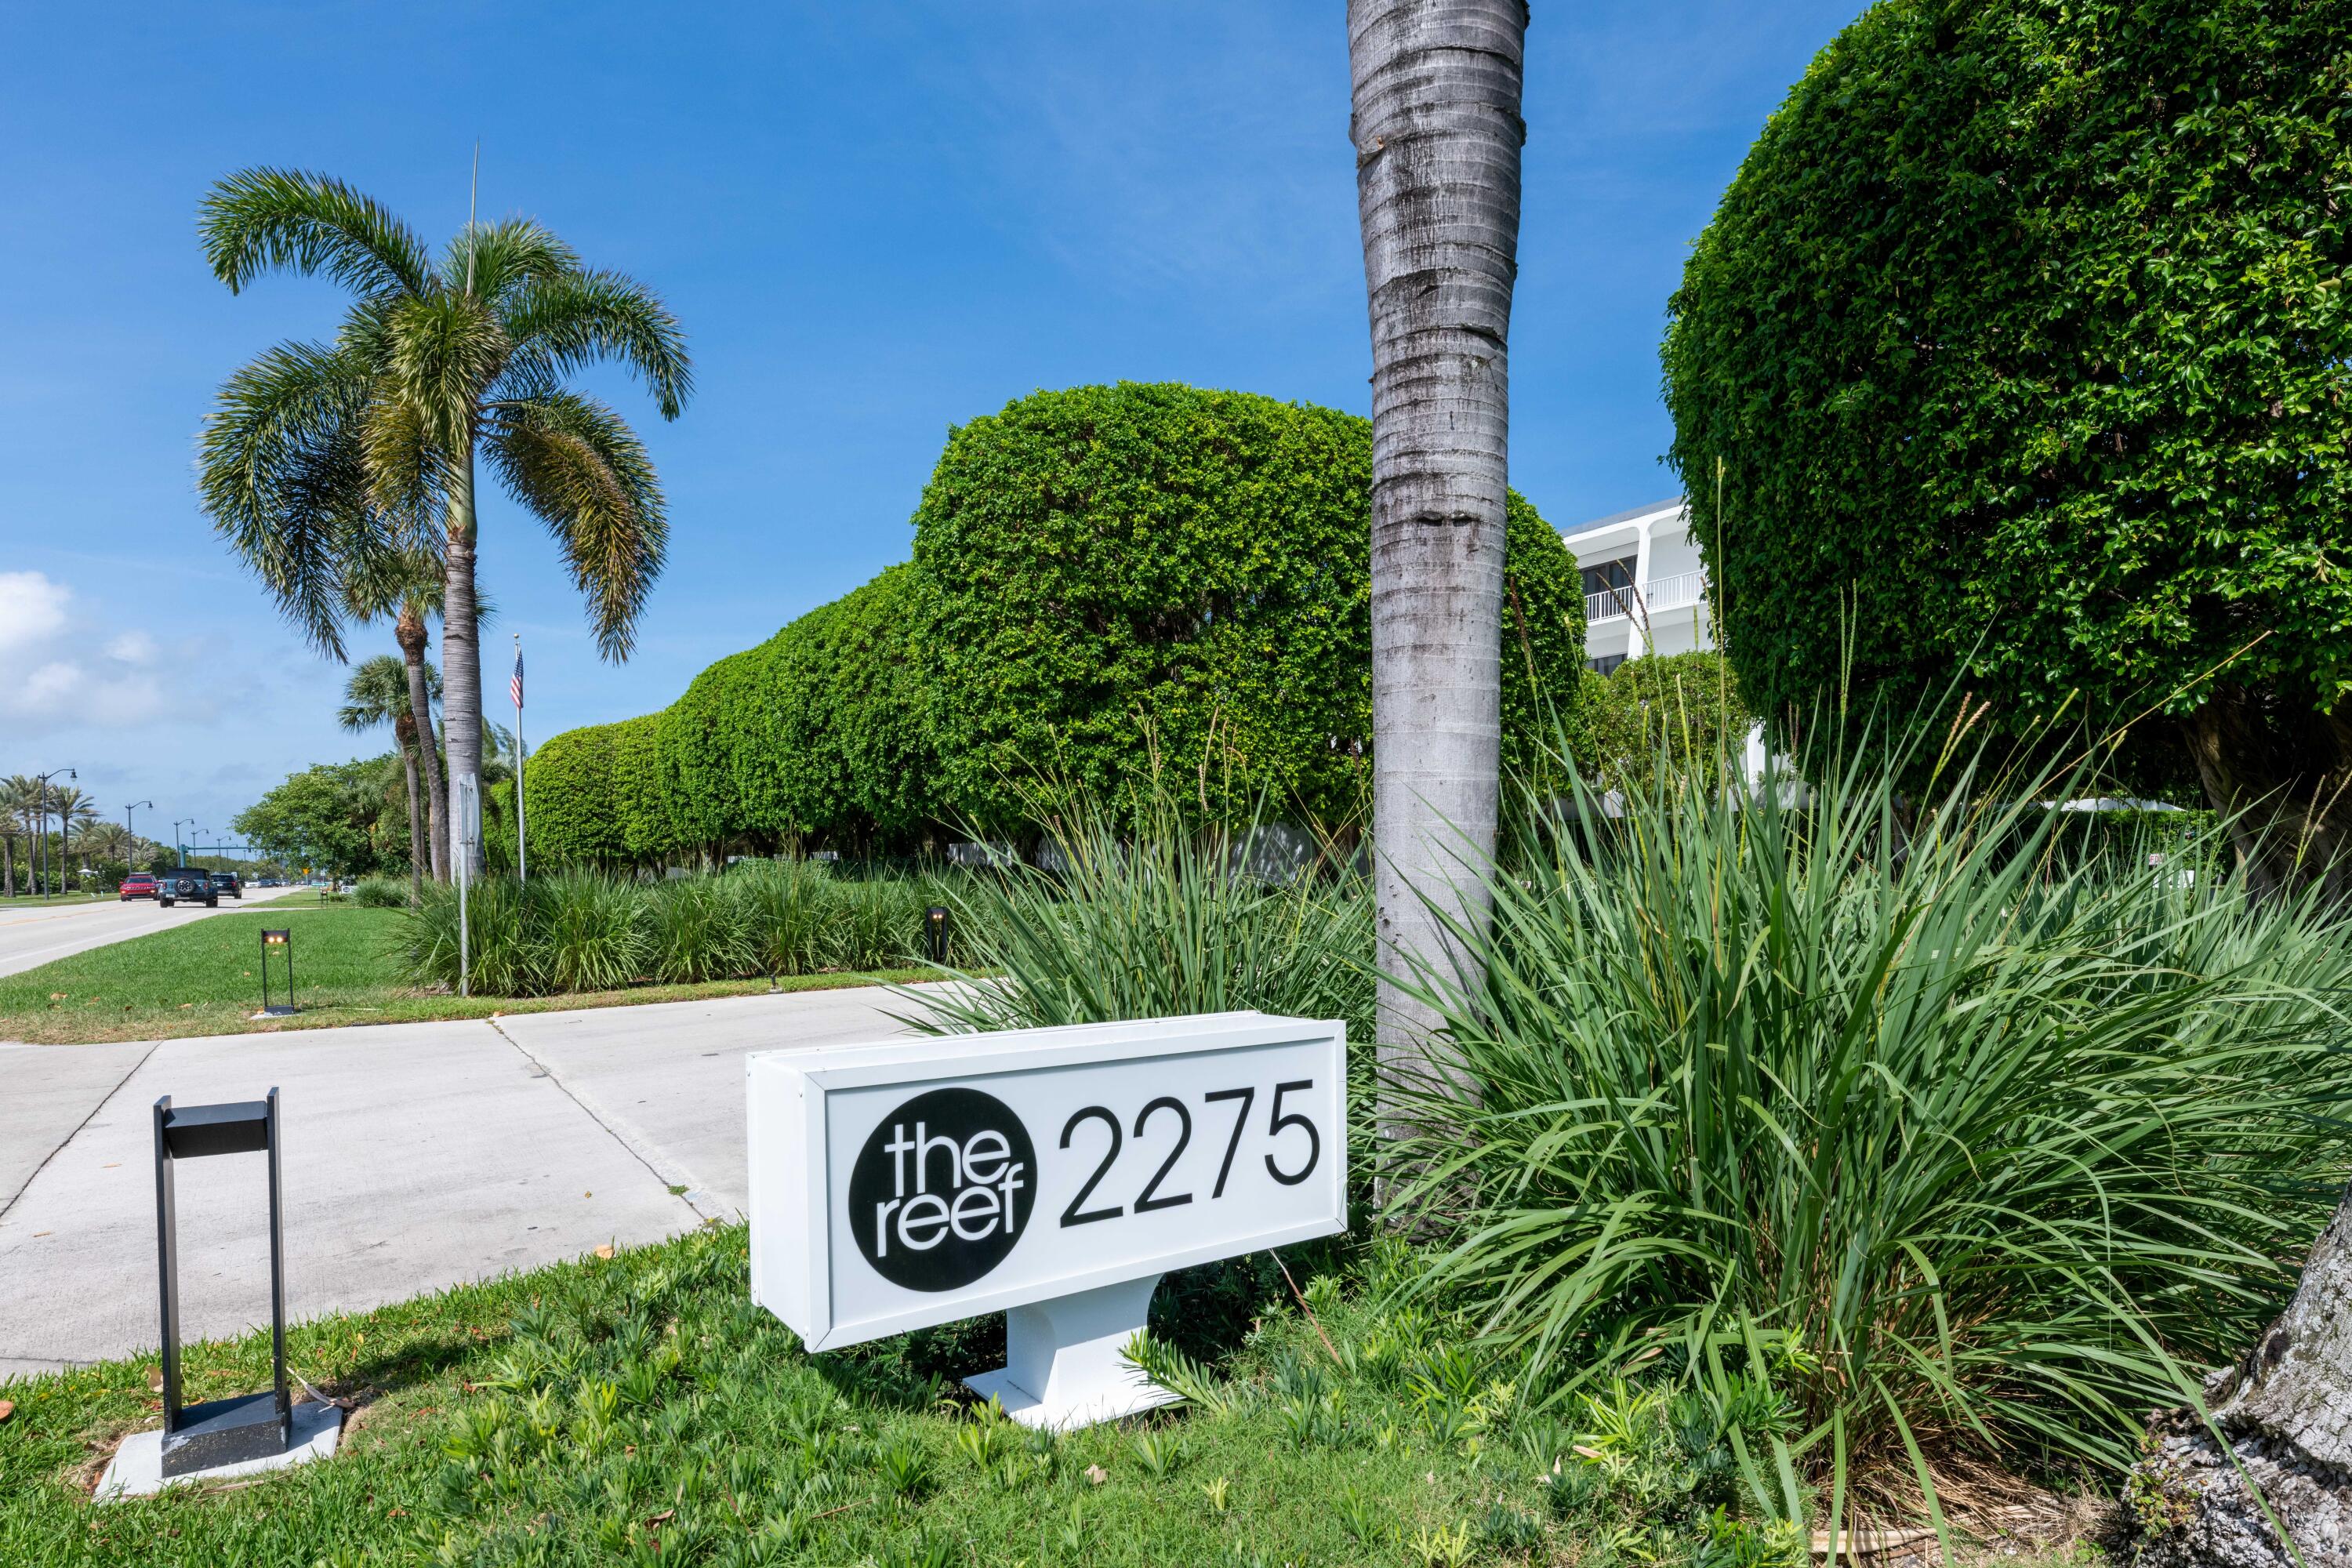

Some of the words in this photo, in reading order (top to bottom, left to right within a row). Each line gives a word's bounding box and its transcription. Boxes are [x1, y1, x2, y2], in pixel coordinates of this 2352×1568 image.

[884, 1121, 1011, 1198] the
[1060, 1080, 1320, 1229] 2275
[877, 1162, 1024, 1258] reef
